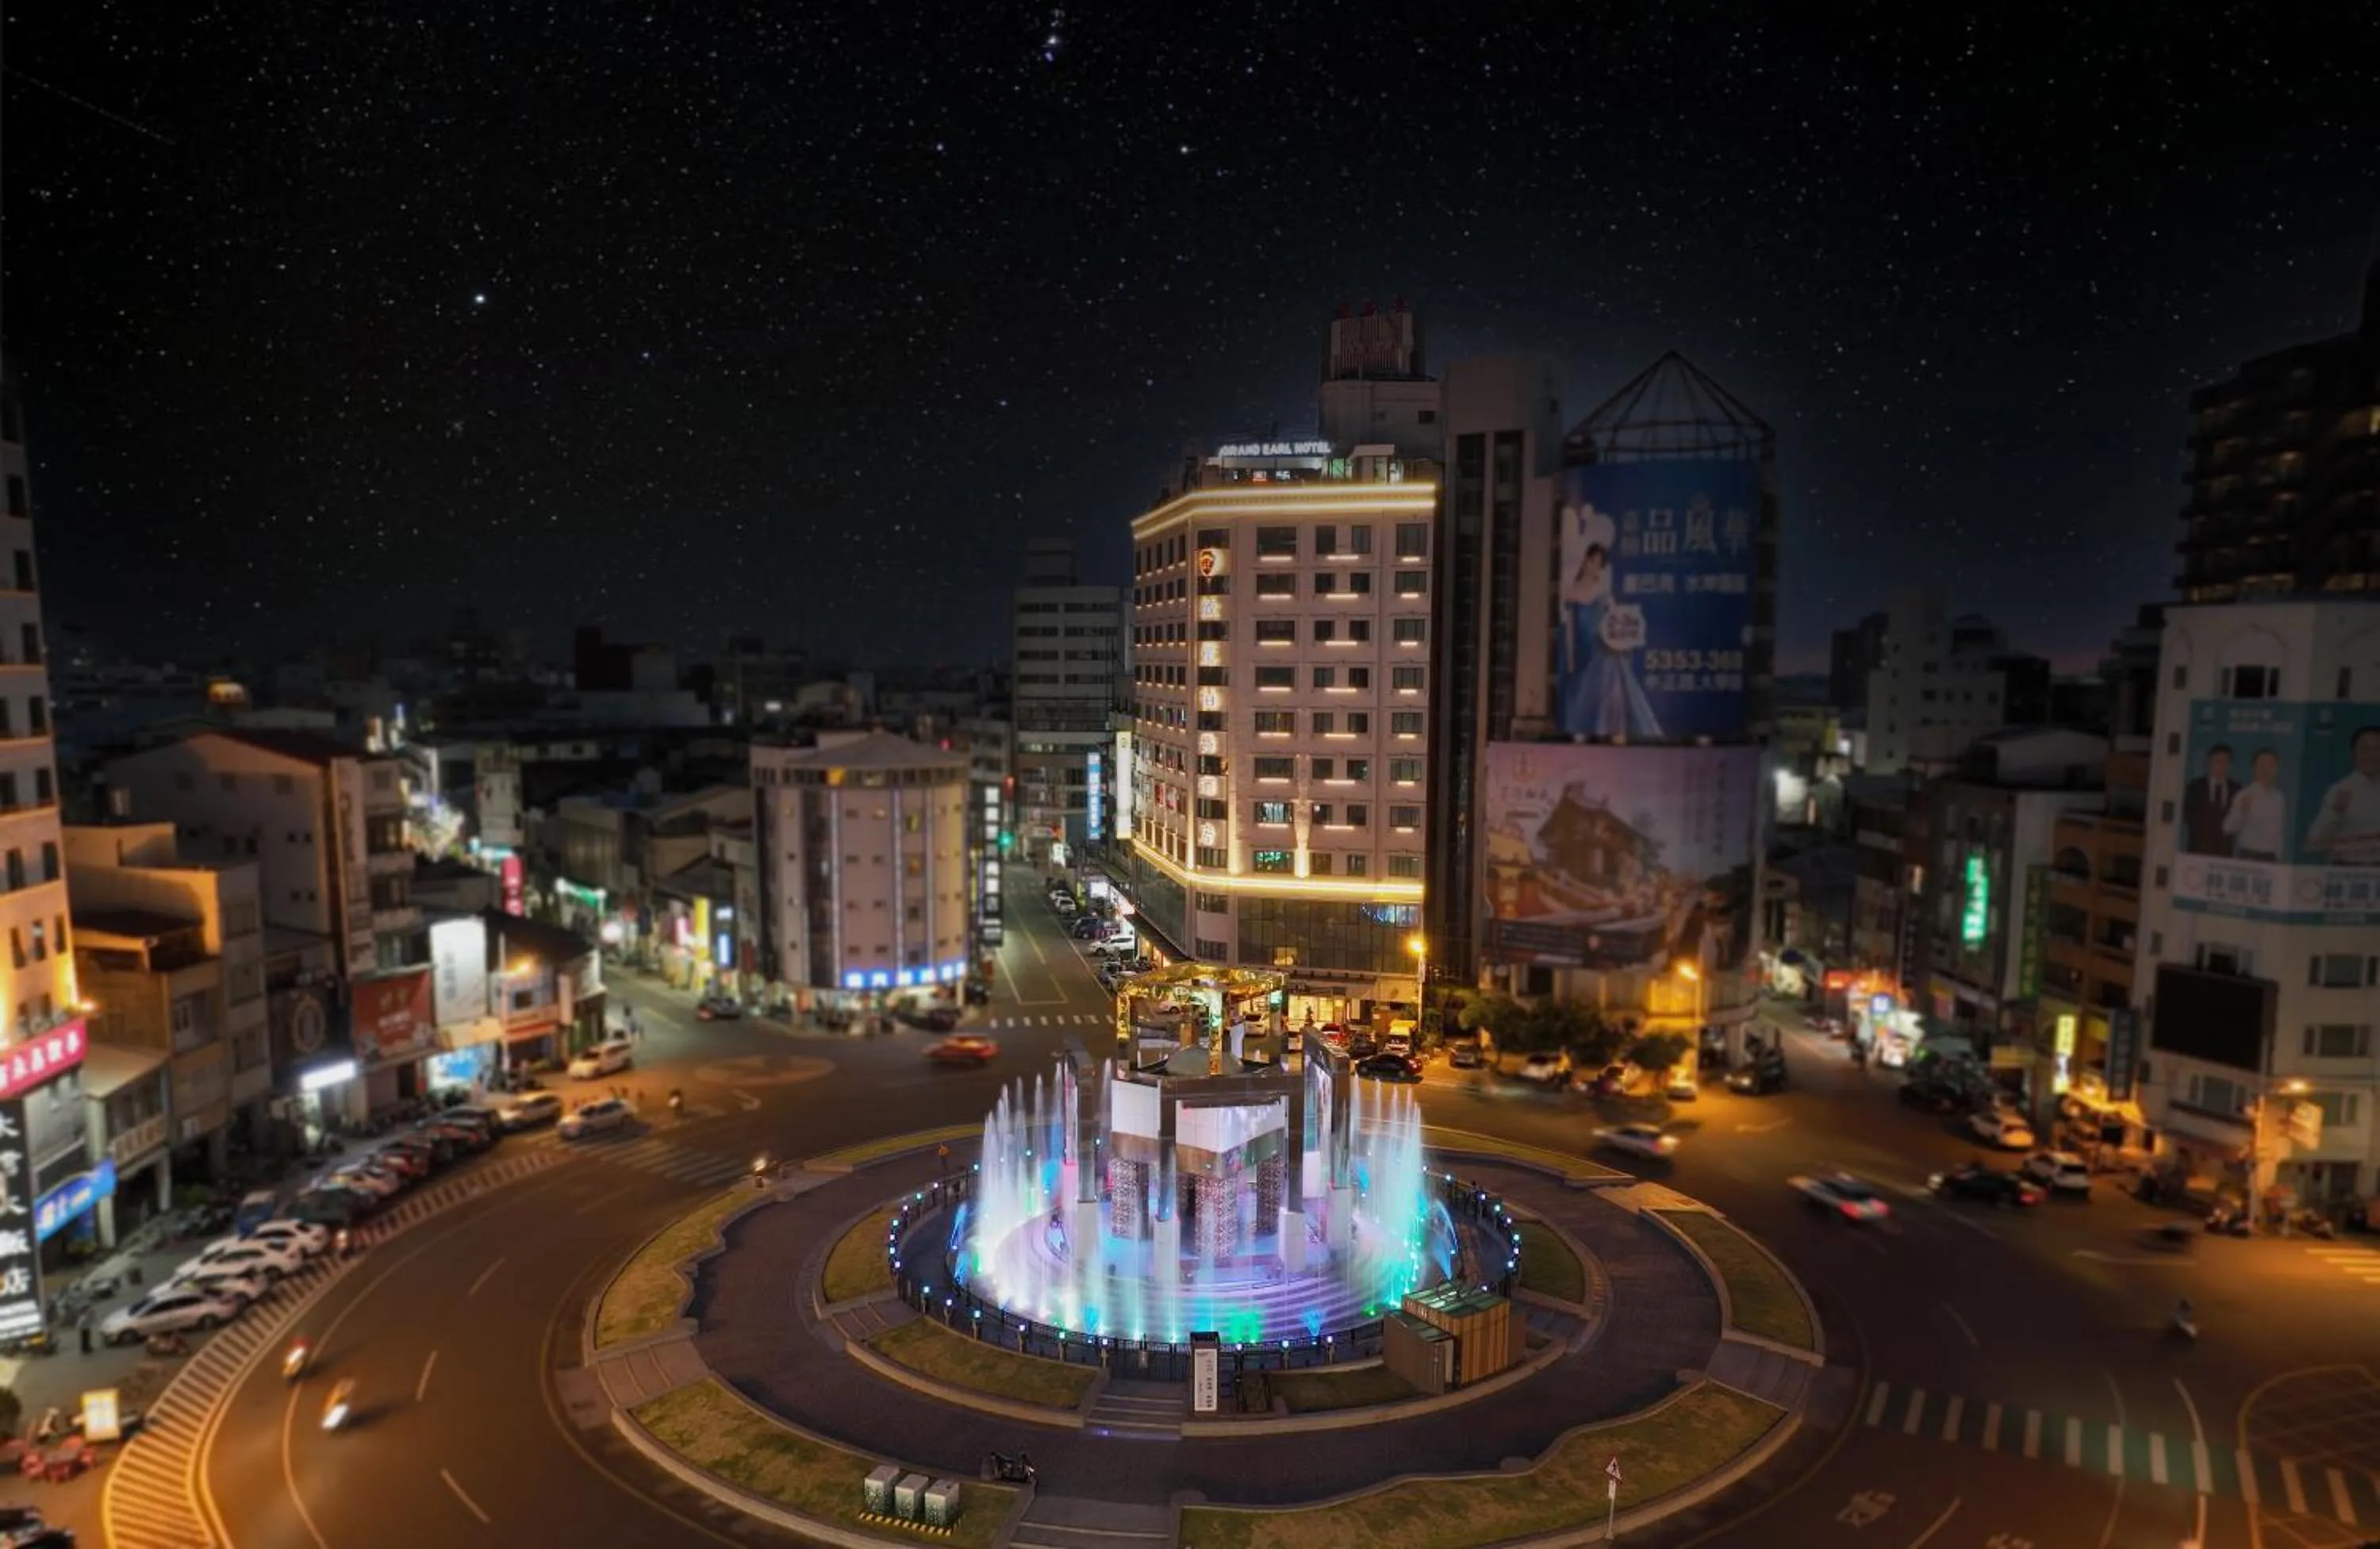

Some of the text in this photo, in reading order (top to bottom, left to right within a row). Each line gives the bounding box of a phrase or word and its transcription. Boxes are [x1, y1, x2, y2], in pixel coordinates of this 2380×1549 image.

[1219, 441, 1331, 456] GRAND EARL HOTEL
